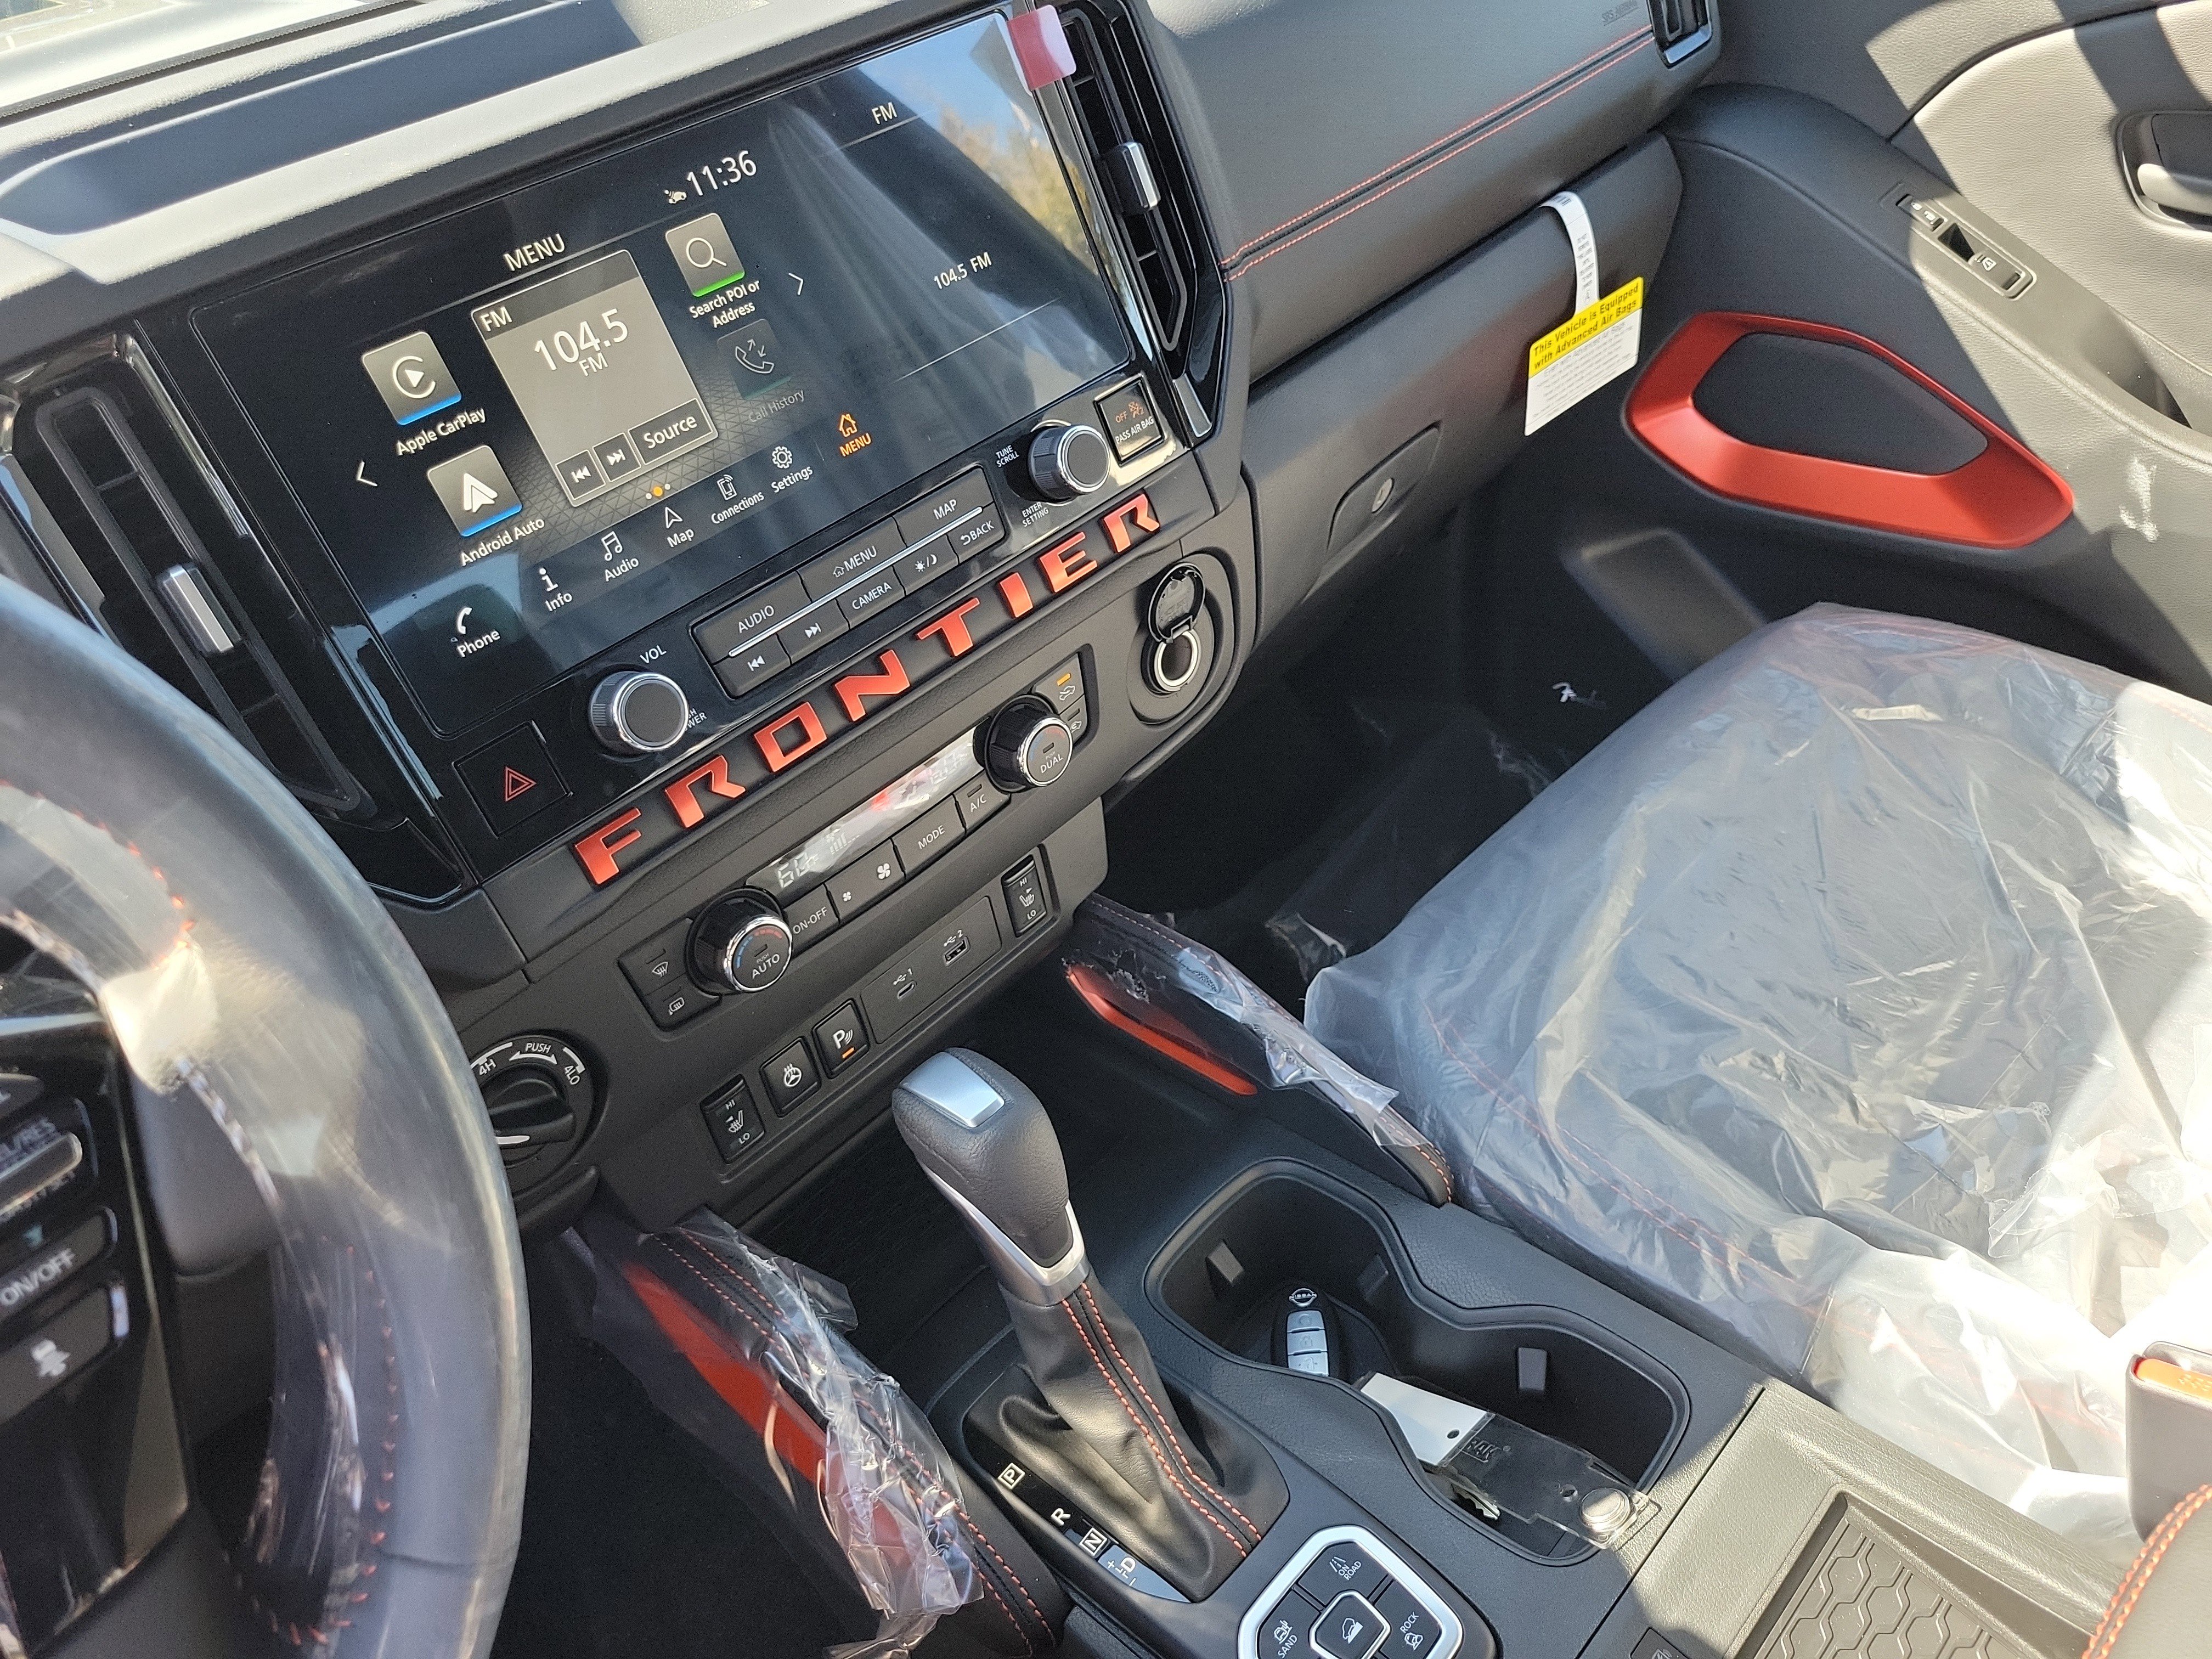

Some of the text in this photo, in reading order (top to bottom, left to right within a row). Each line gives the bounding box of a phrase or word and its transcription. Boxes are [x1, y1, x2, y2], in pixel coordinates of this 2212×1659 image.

[872, 102, 897, 125] FM
[686, 150, 757, 196] 11:36
[503, 233, 566, 272] MENU
[933, 252, 992, 290] 104.5 FM
[689, 279, 760, 319] Search POI or
[481, 307, 512, 332] FM
[712, 301, 755, 328] Address
[1533, 283, 1639, 357] This Vehicle is Equipped
[534, 308, 628, 371] 104.5
[1534, 300, 1637, 370] with Advanced Air Bags
[579, 352, 608, 376] FM
[748, 390, 805, 422] Call History
[1115, 411, 1127, 423] OFF
[396, 408, 487, 456] Apple CarPlay
[644, 413, 697, 449] Source
[1115, 416, 1154, 445] PASS AIR BAG
[839, 433, 872, 456] MENU
[996, 445, 1013, 459] TUNE
[996, 451, 1019, 467] SCROLL
[771, 465, 814, 493] Settings
[710, 491, 765, 525] Connections
[933, 499, 958, 521] MAP
[1022, 502, 1042, 517] ENTER
[1023, 507, 1049, 528] SETTING
[460, 517, 545, 567] Android Auto
[667, 528, 695, 549] Map
[970, 520, 995, 542] BACK
[603, 556, 639, 582] Audio
[844, 545, 878, 573] MENU
[545, 591, 573, 612] Info
[851, 582, 893, 611] CAMERA
[737, 605, 775, 634] AUDIO
[457, 629, 501, 658] Phone
[640, 645, 667, 665] VOL
[575, 493, 1160, 885] FRONTIER
[1040, 754, 1063, 774] DUAL
[969, 794, 988, 812] A/C
[918, 825, 945, 850] MODE
[1019, 878, 1028, 887] HI
[1027, 910, 1037, 920] LO
[958, 929, 963, 939] 2
[752, 953, 780, 979] AUTO
[908, 968, 912, 976] 1
[525, 1042, 552, 1054] PUSH
[479, 1059, 496, 1075] 4H
[564, 1065, 580, 1086] 4LO
[726, 1099, 736, 1109] HI
[738, 1133, 751, 1144] LO
[1, 1248, 76, 1307] ON/OFF
[1005, 1469, 1017, 1483] P
[1051, 1507, 1071, 1525] R
[1084, 1532, 1103, 1551] N
[1120, 1557, 1136, 1573] D
[1338, 1563, 1350, 1577] ON
[1344, 1560, 1362, 1581] ROAD
[1400, 1611, 1419, 1634] ROCK
[1278, 1635, 1298, 1659] SAND
